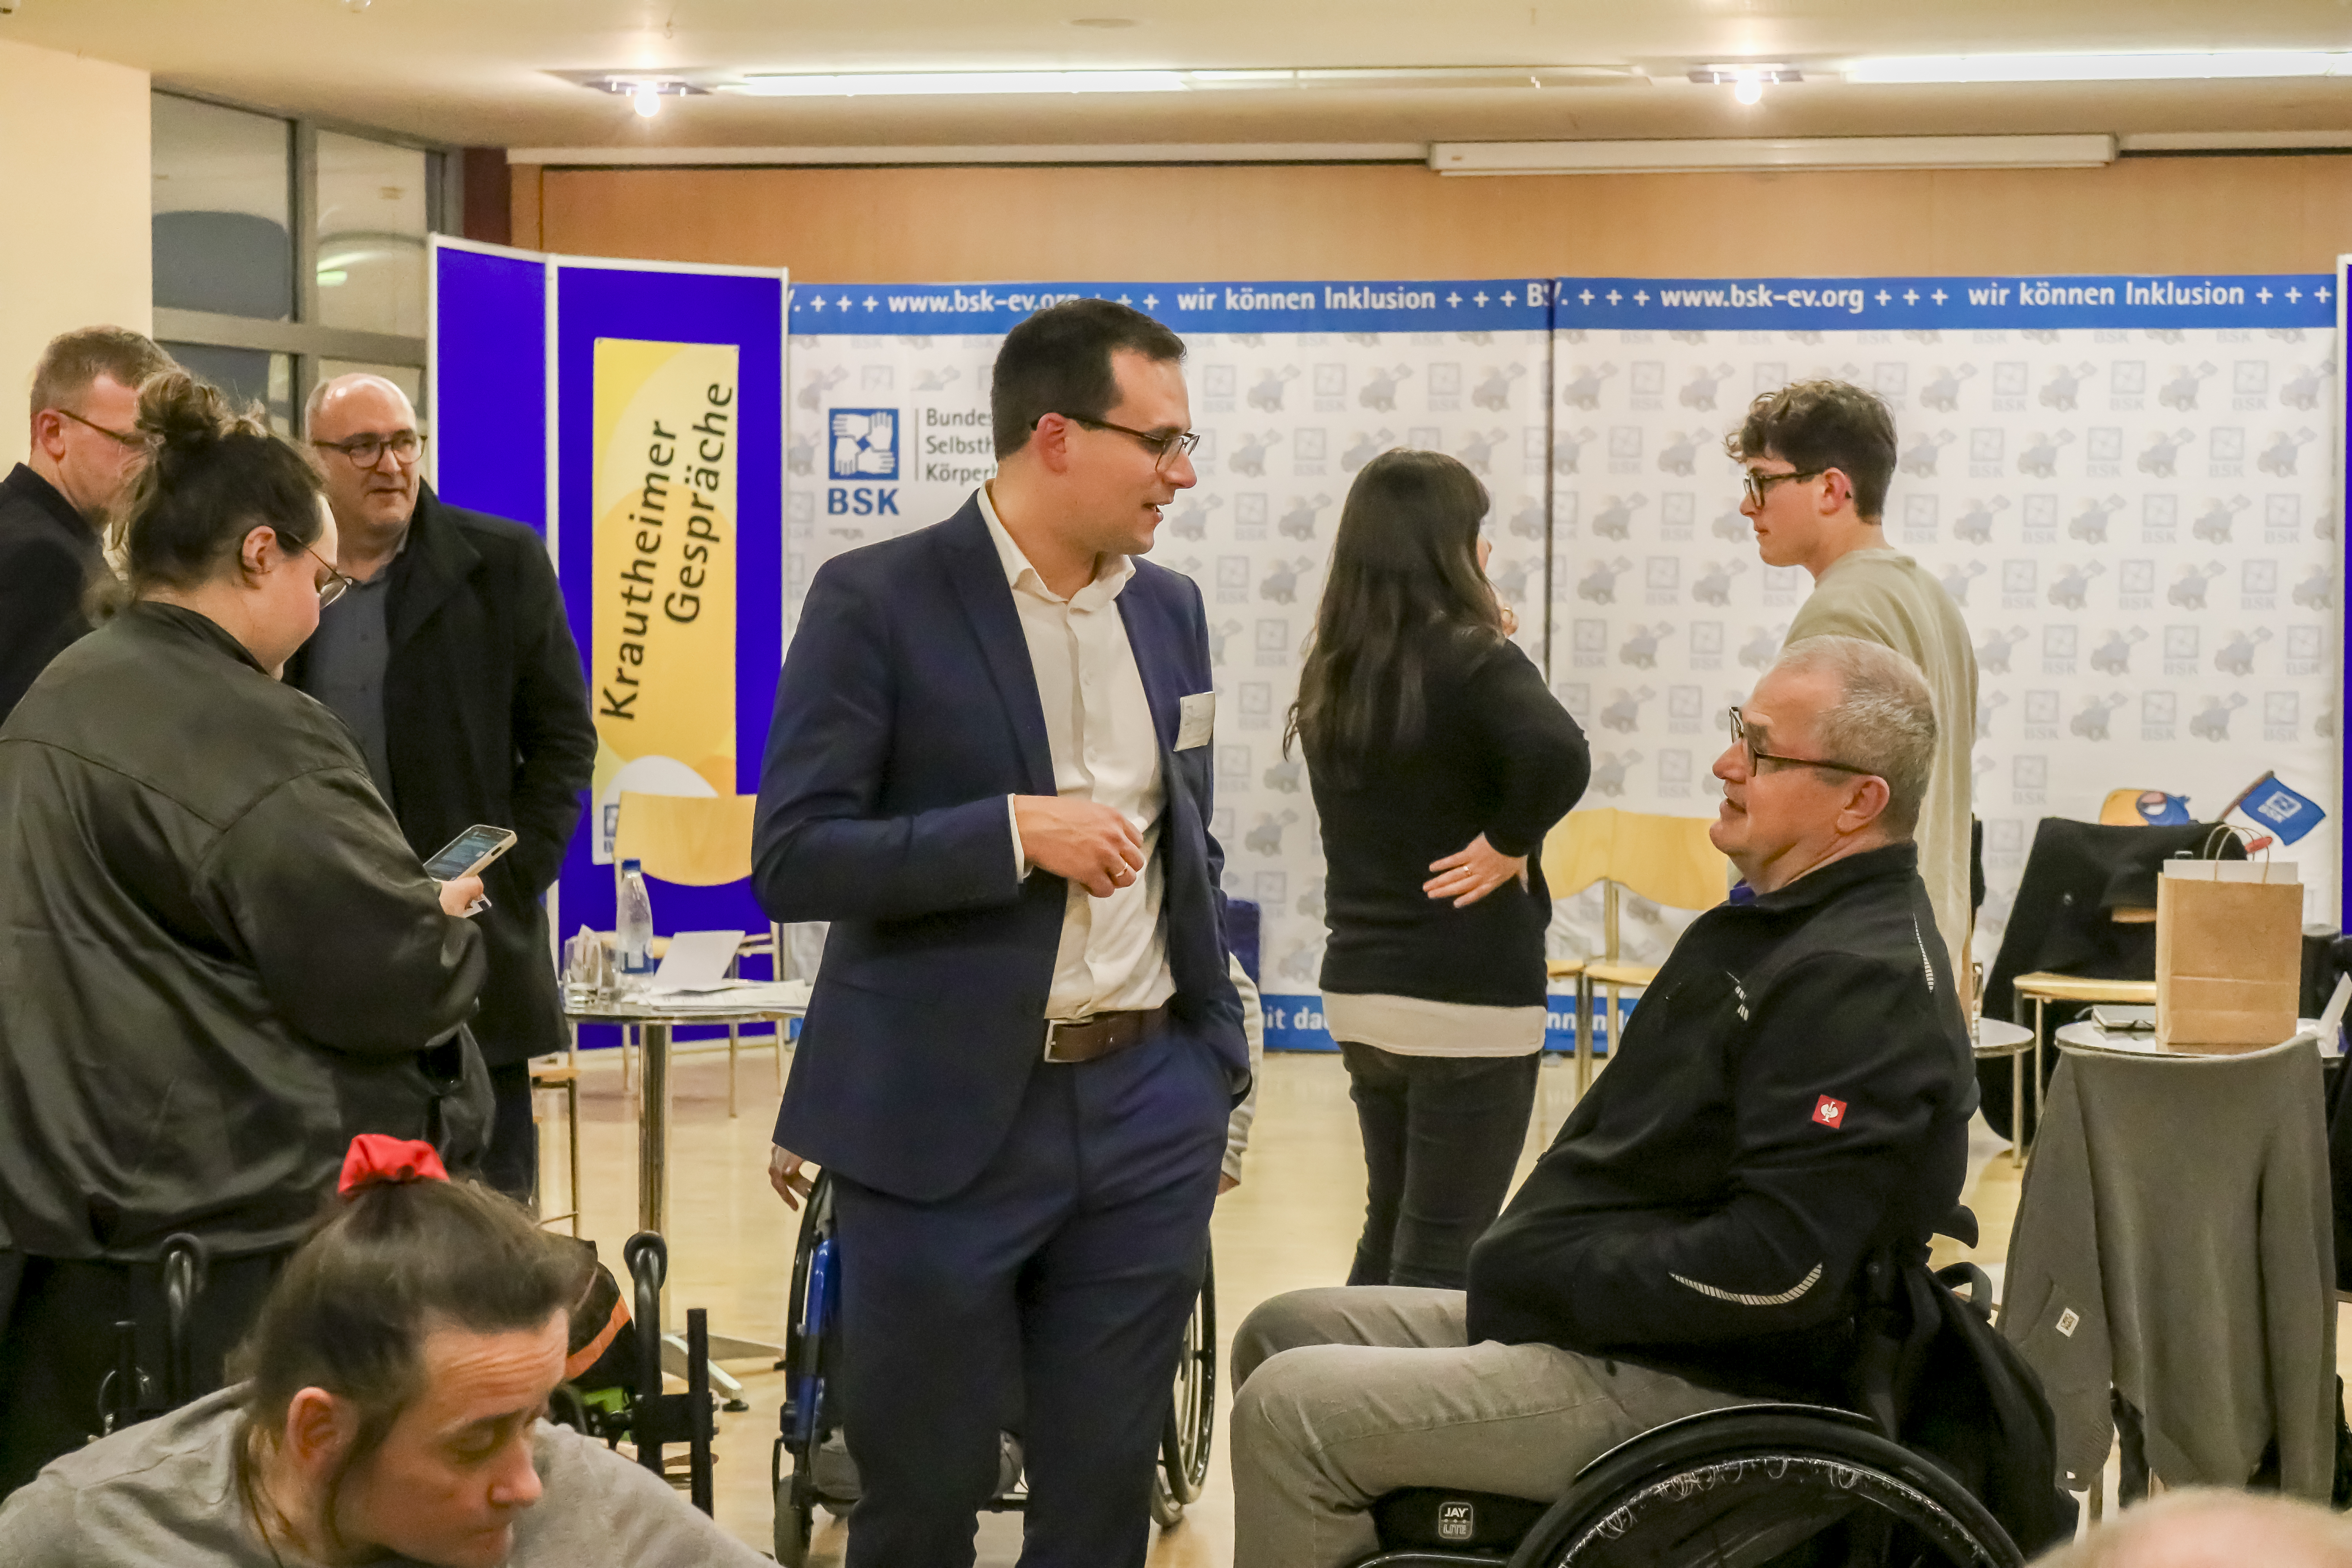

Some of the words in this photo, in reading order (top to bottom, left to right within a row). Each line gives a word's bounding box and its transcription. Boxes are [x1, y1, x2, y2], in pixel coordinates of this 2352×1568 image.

[1177, 287, 1217, 310] wir
[1225, 287, 1316, 310] können
[1325, 286, 1436, 309] Inklusion
[1661, 284, 1864, 314] www.bsk-ev.org
[1968, 281, 2010, 306] wir
[2020, 281, 2115, 306] können
[2126, 280, 2245, 305] Inklusion
[664, 382, 732, 624] Gespräche
[828, 487, 900, 516] BSK
[599, 419, 676, 720] Krautheimer
[1444, 1507, 1469, 1518] JAY
